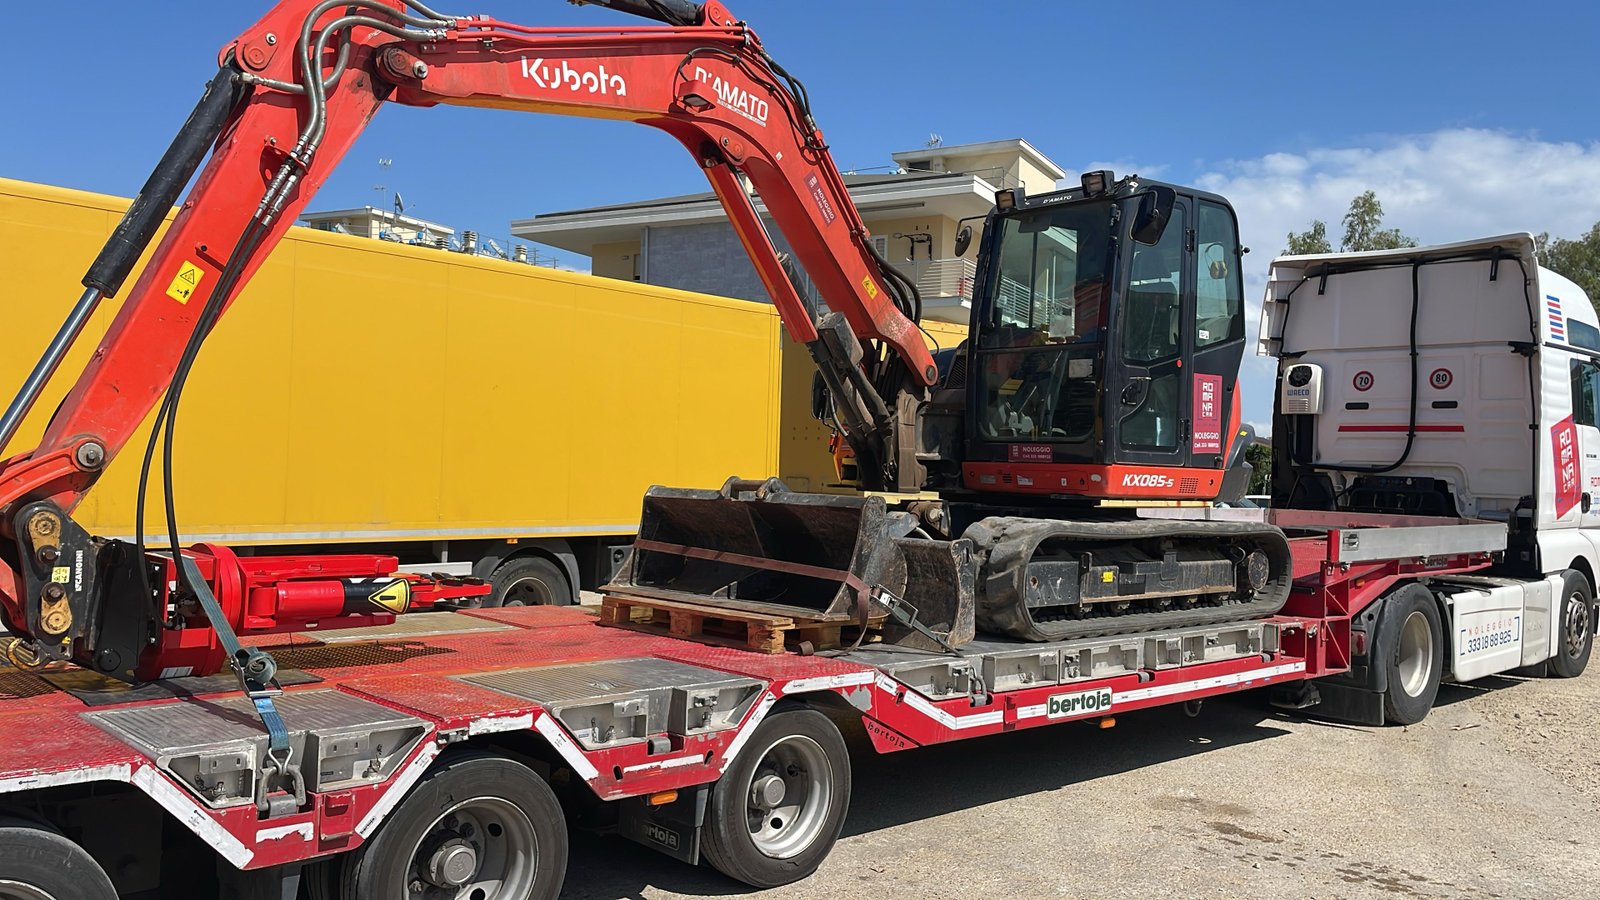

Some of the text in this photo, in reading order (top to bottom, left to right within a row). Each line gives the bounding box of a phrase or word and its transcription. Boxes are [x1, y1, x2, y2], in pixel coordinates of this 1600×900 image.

[521, 56, 627, 97] Kubota
[817, 188, 835, 220] NOLEGGIO
[1043, 195, 1072, 204] D'AMATO
[1359, 376, 1370, 386] 70
[1435, 373, 1448, 383] 80
[1202, 382, 1214, 392] RO
[1202, 402, 1213, 412] NA
[1194, 432, 1219, 440] NOLEGGIO
[1559, 428, 1572, 449] RO
[1562, 462, 1575, 484] NA
[1563, 478, 1575, 494] CAR
[1468, 618, 1513, 637] NOLEGGIO
[1049, 691, 1112, 715] bertoja
[867, 721, 905, 748] bertoja
